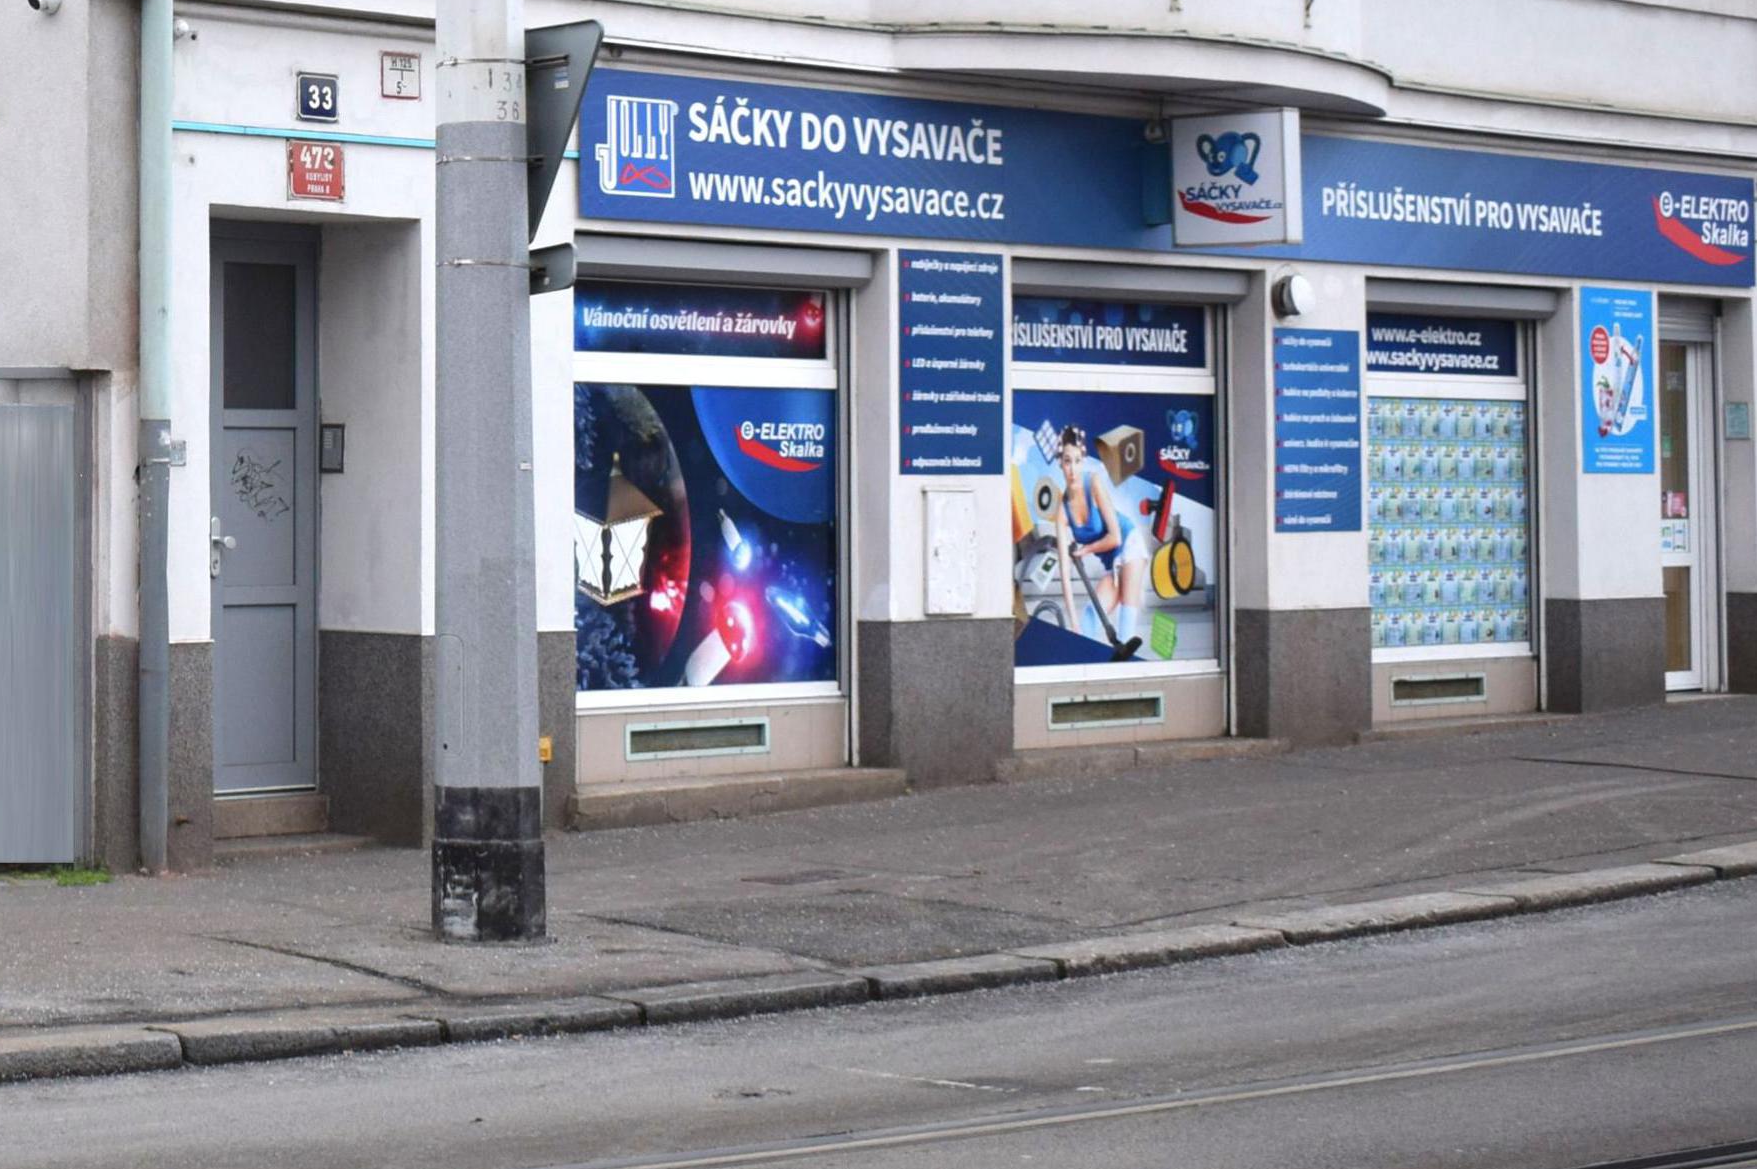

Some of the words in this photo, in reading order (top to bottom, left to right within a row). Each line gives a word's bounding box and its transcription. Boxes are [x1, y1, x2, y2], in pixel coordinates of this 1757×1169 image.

[308, 84, 333, 111] 33
[688, 96, 792, 148] SÁČKY
[801, 112, 845, 152] DO
[852, 118, 1003, 166] VYSAVAČE
[300, 144, 334, 170] 473
[688, 171, 1005, 221] www.sackyvysavace.cz
[1186, 182, 1242, 201] SÁČKY
[1321, 181, 1470, 227] PŘÍSLUŠENSTVÍ
[1474, 199, 1513, 230] PRO
[1516, 197, 1603, 238] VYSAVAČE
[1701, 221, 1748, 247] Skalka
[583, 306, 647, 329] Vánoční
[649, 310, 722, 333] osvětlení
[723, 317, 733, 332] a
[734, 313, 797, 340] žárovky
[1012, 315, 1094, 349] ÍSLUŠENSTVÍ
[1096, 326, 1123, 350] PRO
[1126, 323, 1188, 353] VYSAVAČE
[1371, 326, 1482, 346] www.e-elektro.cz
[1367, 348, 1499, 371] ww.sackyvysavace.cz
[779, 440, 824, 458] Skalka
